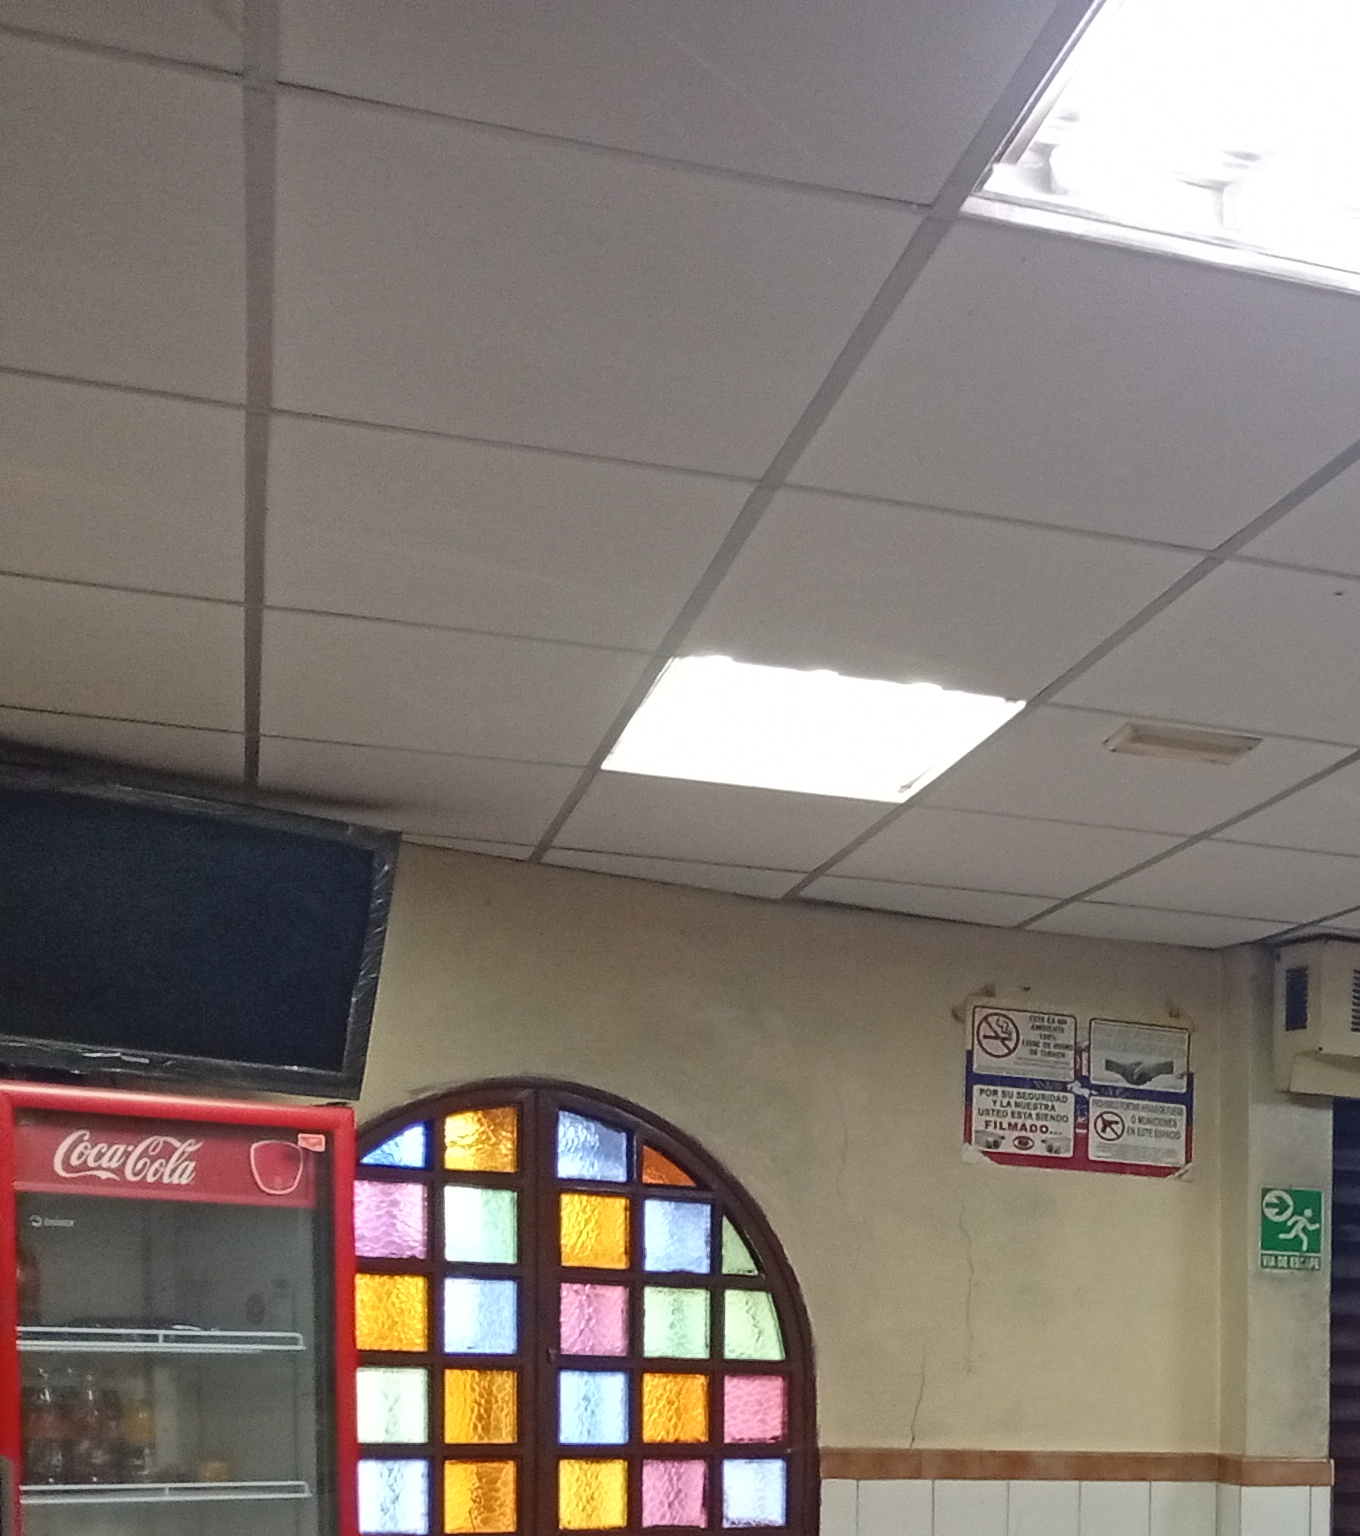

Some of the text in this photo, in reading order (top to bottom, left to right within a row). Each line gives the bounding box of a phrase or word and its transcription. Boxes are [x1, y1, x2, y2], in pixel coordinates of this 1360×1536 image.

[979, 1088, 1069, 1104] POR SU SEGURIDAD
[1000, 1100, 1012, 1108] LA
[1014, 1101, 1056, 1112] NUESTRA
[978, 1108, 1070, 1123] USTED ESTA SIENDO
[53, 1129, 204, 1185] Coca-Cola
